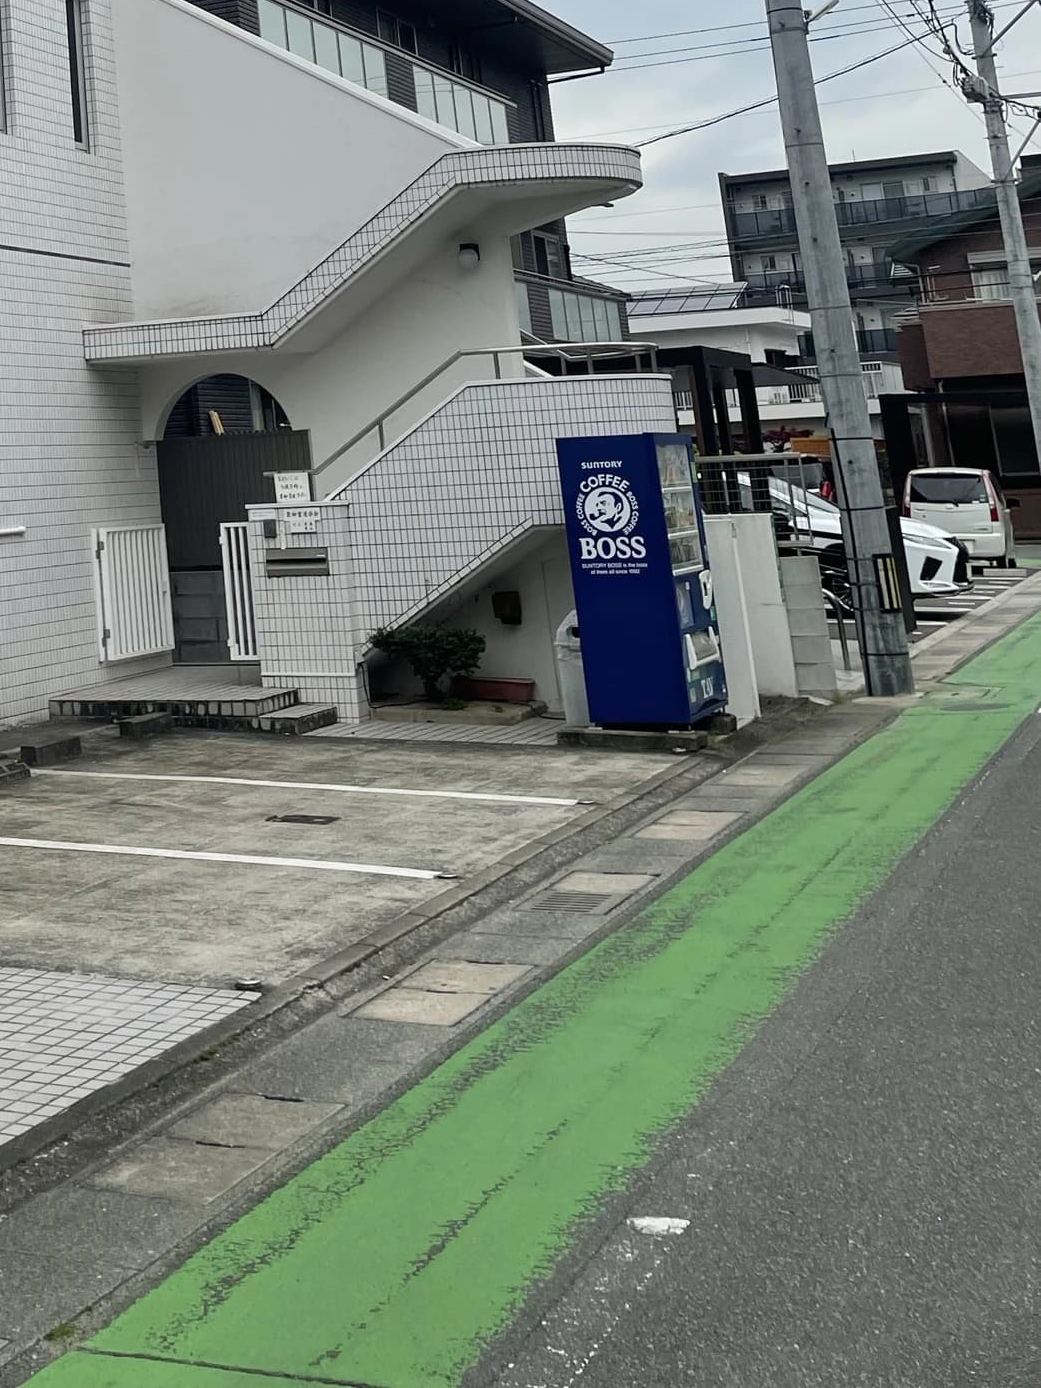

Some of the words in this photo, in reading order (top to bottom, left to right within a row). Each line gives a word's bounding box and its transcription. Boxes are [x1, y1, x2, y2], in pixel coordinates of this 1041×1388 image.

[581, 460, 623, 469] SUNTORY
[579, 473, 630, 494] COFFEE
[579, 536, 647, 559] BOSS
